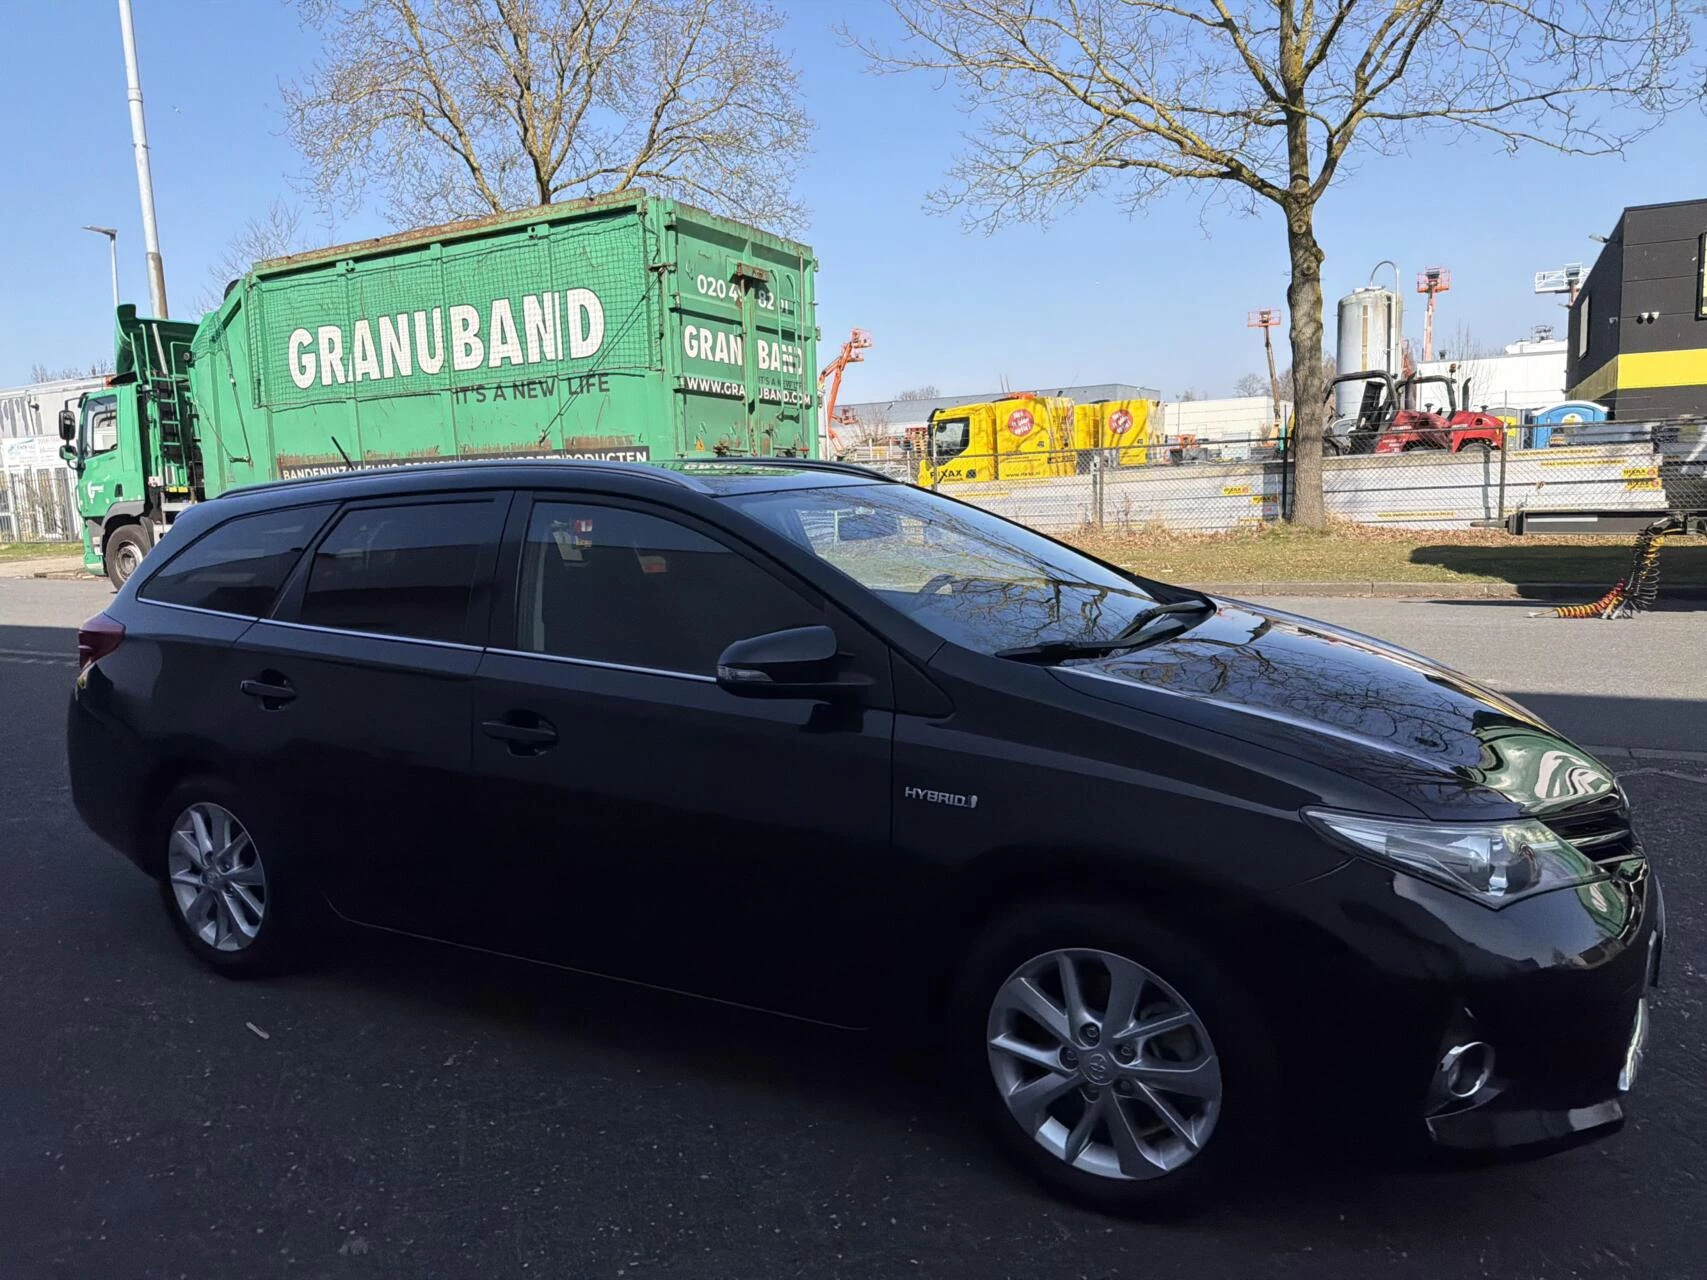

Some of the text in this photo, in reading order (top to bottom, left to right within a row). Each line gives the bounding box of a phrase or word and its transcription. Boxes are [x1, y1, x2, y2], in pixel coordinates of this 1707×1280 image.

[697, 274, 726, 299] 020
[758, 290, 774, 310] 82
[288, 287, 605, 389] GRANUBAND
[684, 324, 803, 376] GRANBAND
[455, 374, 610, 405] IT'S A NEW LIFE
[686, 376, 811, 405] WWW.GRAUBAND.COM
[904, 786, 966, 807] HYBRID
